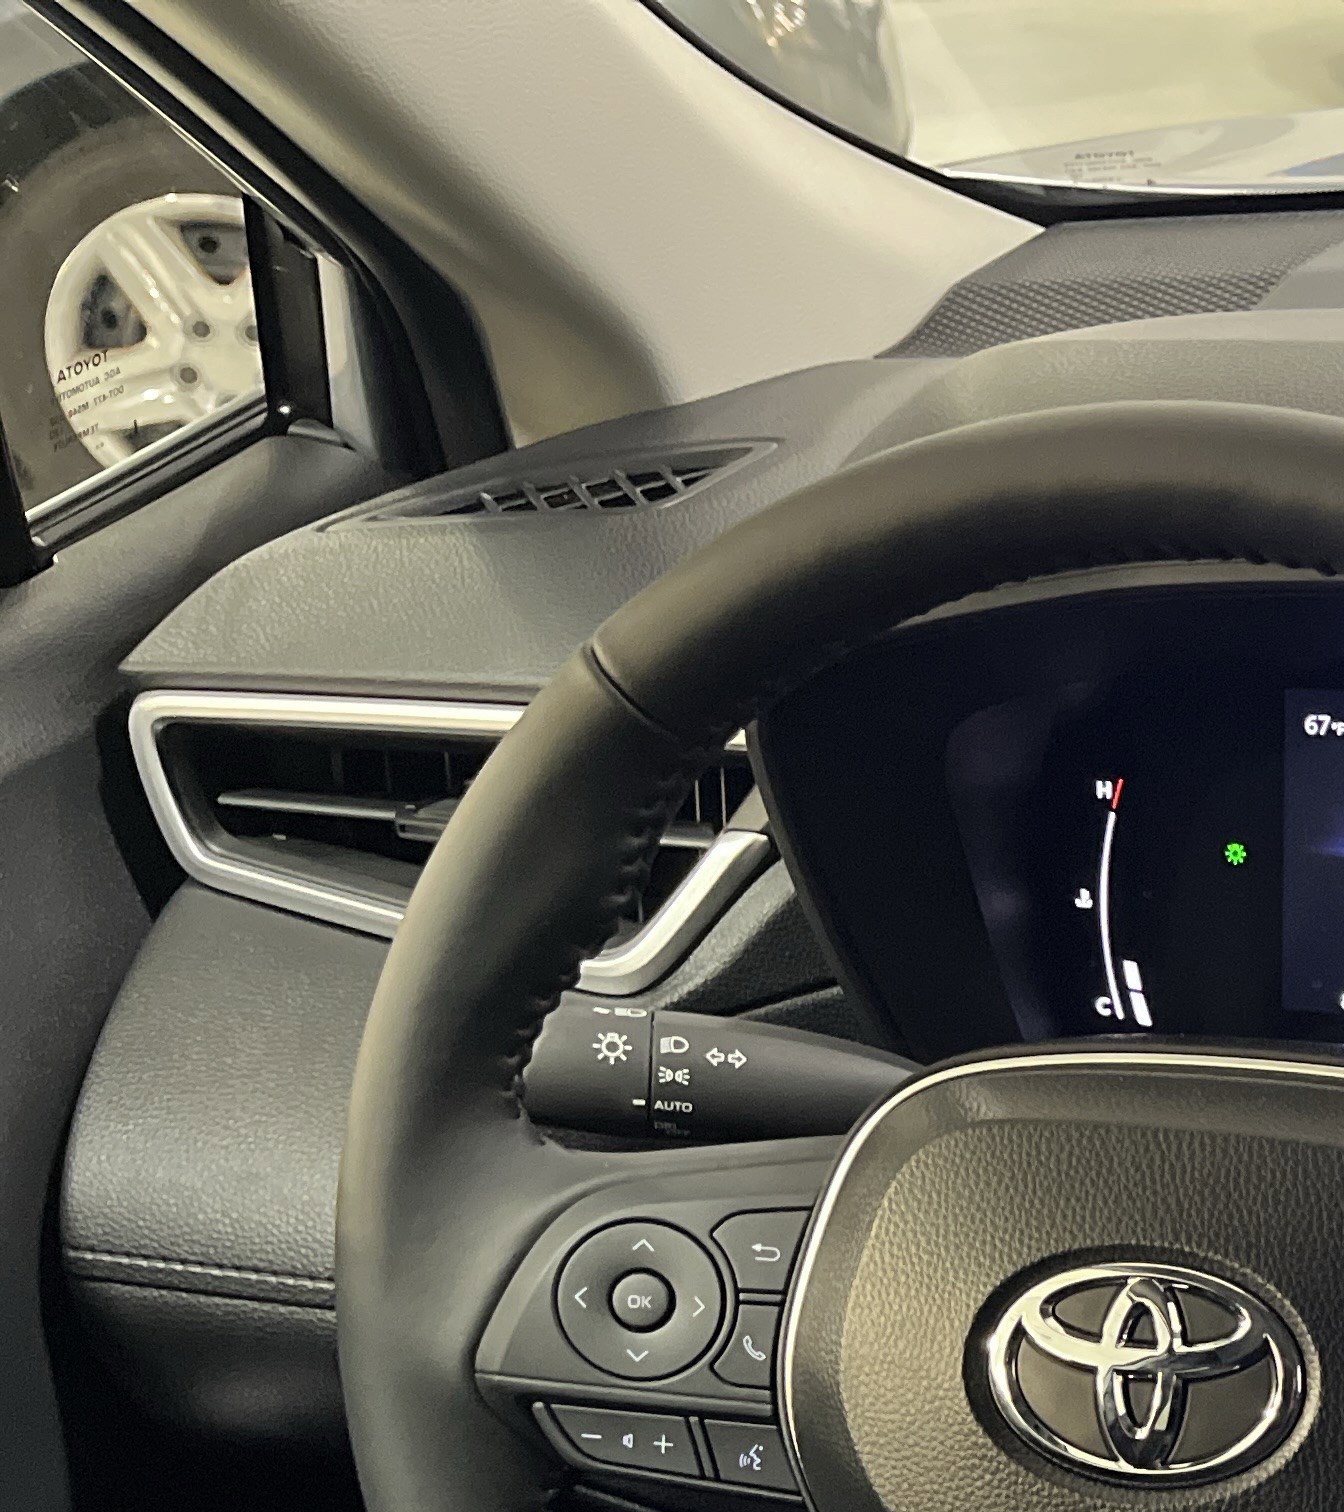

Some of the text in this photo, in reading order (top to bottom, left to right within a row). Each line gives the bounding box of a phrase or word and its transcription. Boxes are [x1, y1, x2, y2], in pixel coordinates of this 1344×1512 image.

[1095, 780, 1113, 800] H
[654, 1099, 693, 1113] AUTO
[627, 1294, 652, 1309] OK
